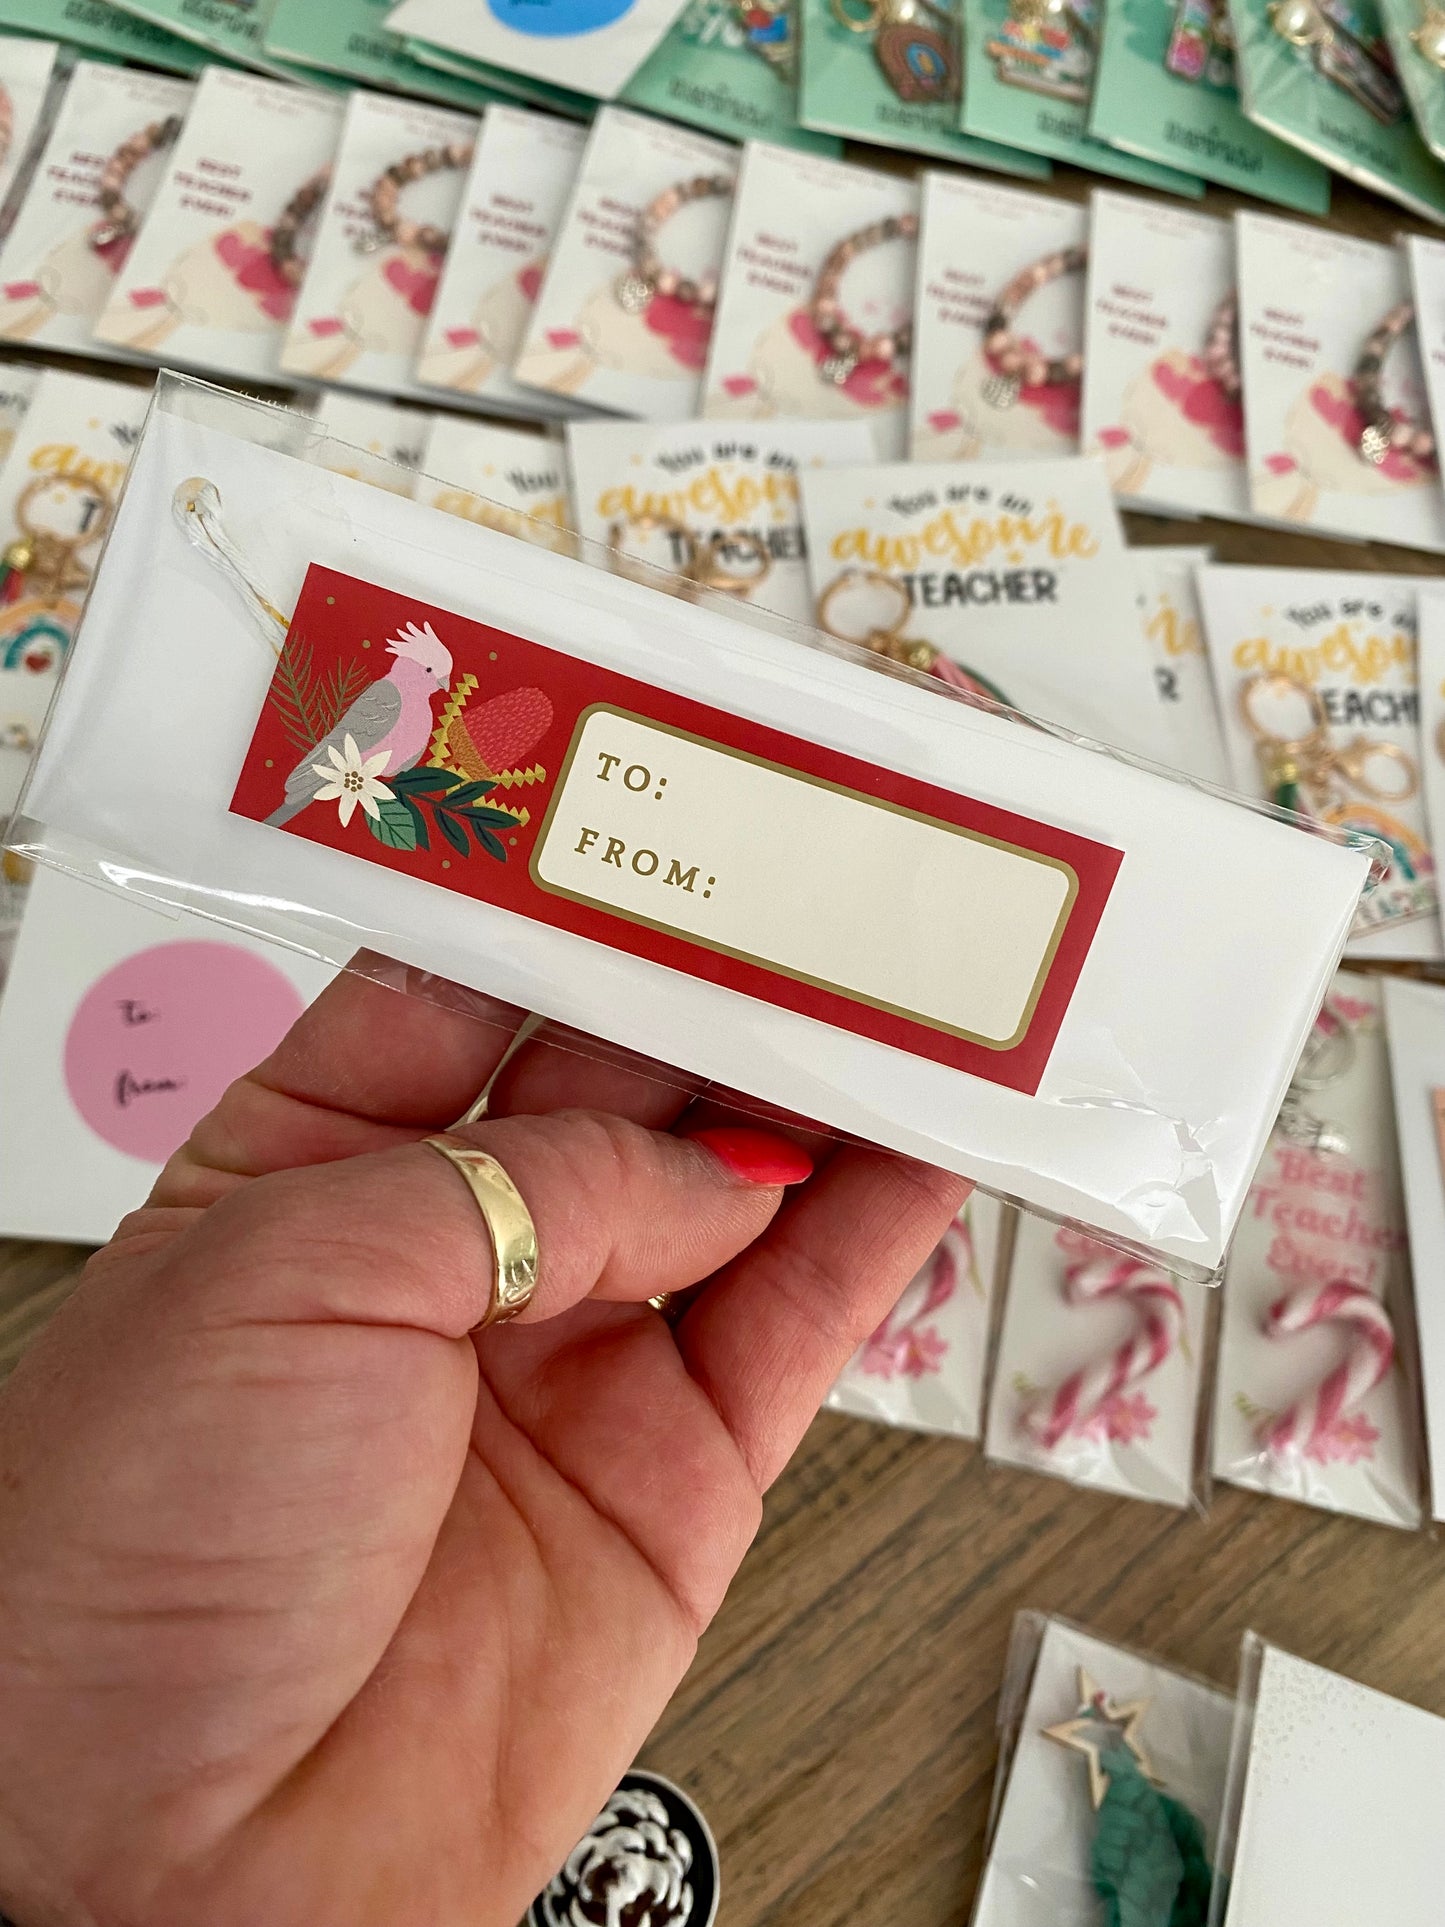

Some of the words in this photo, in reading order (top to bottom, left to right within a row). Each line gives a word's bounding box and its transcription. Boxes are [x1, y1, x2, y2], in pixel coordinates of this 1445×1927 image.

[947, 485, 987, 503] are
[831, 511, 1099, 571] awesome
[903, 568, 1057, 609] TEACHER
[597, 752, 667, 800] TO:
[574, 827, 716, 899] FROM:
